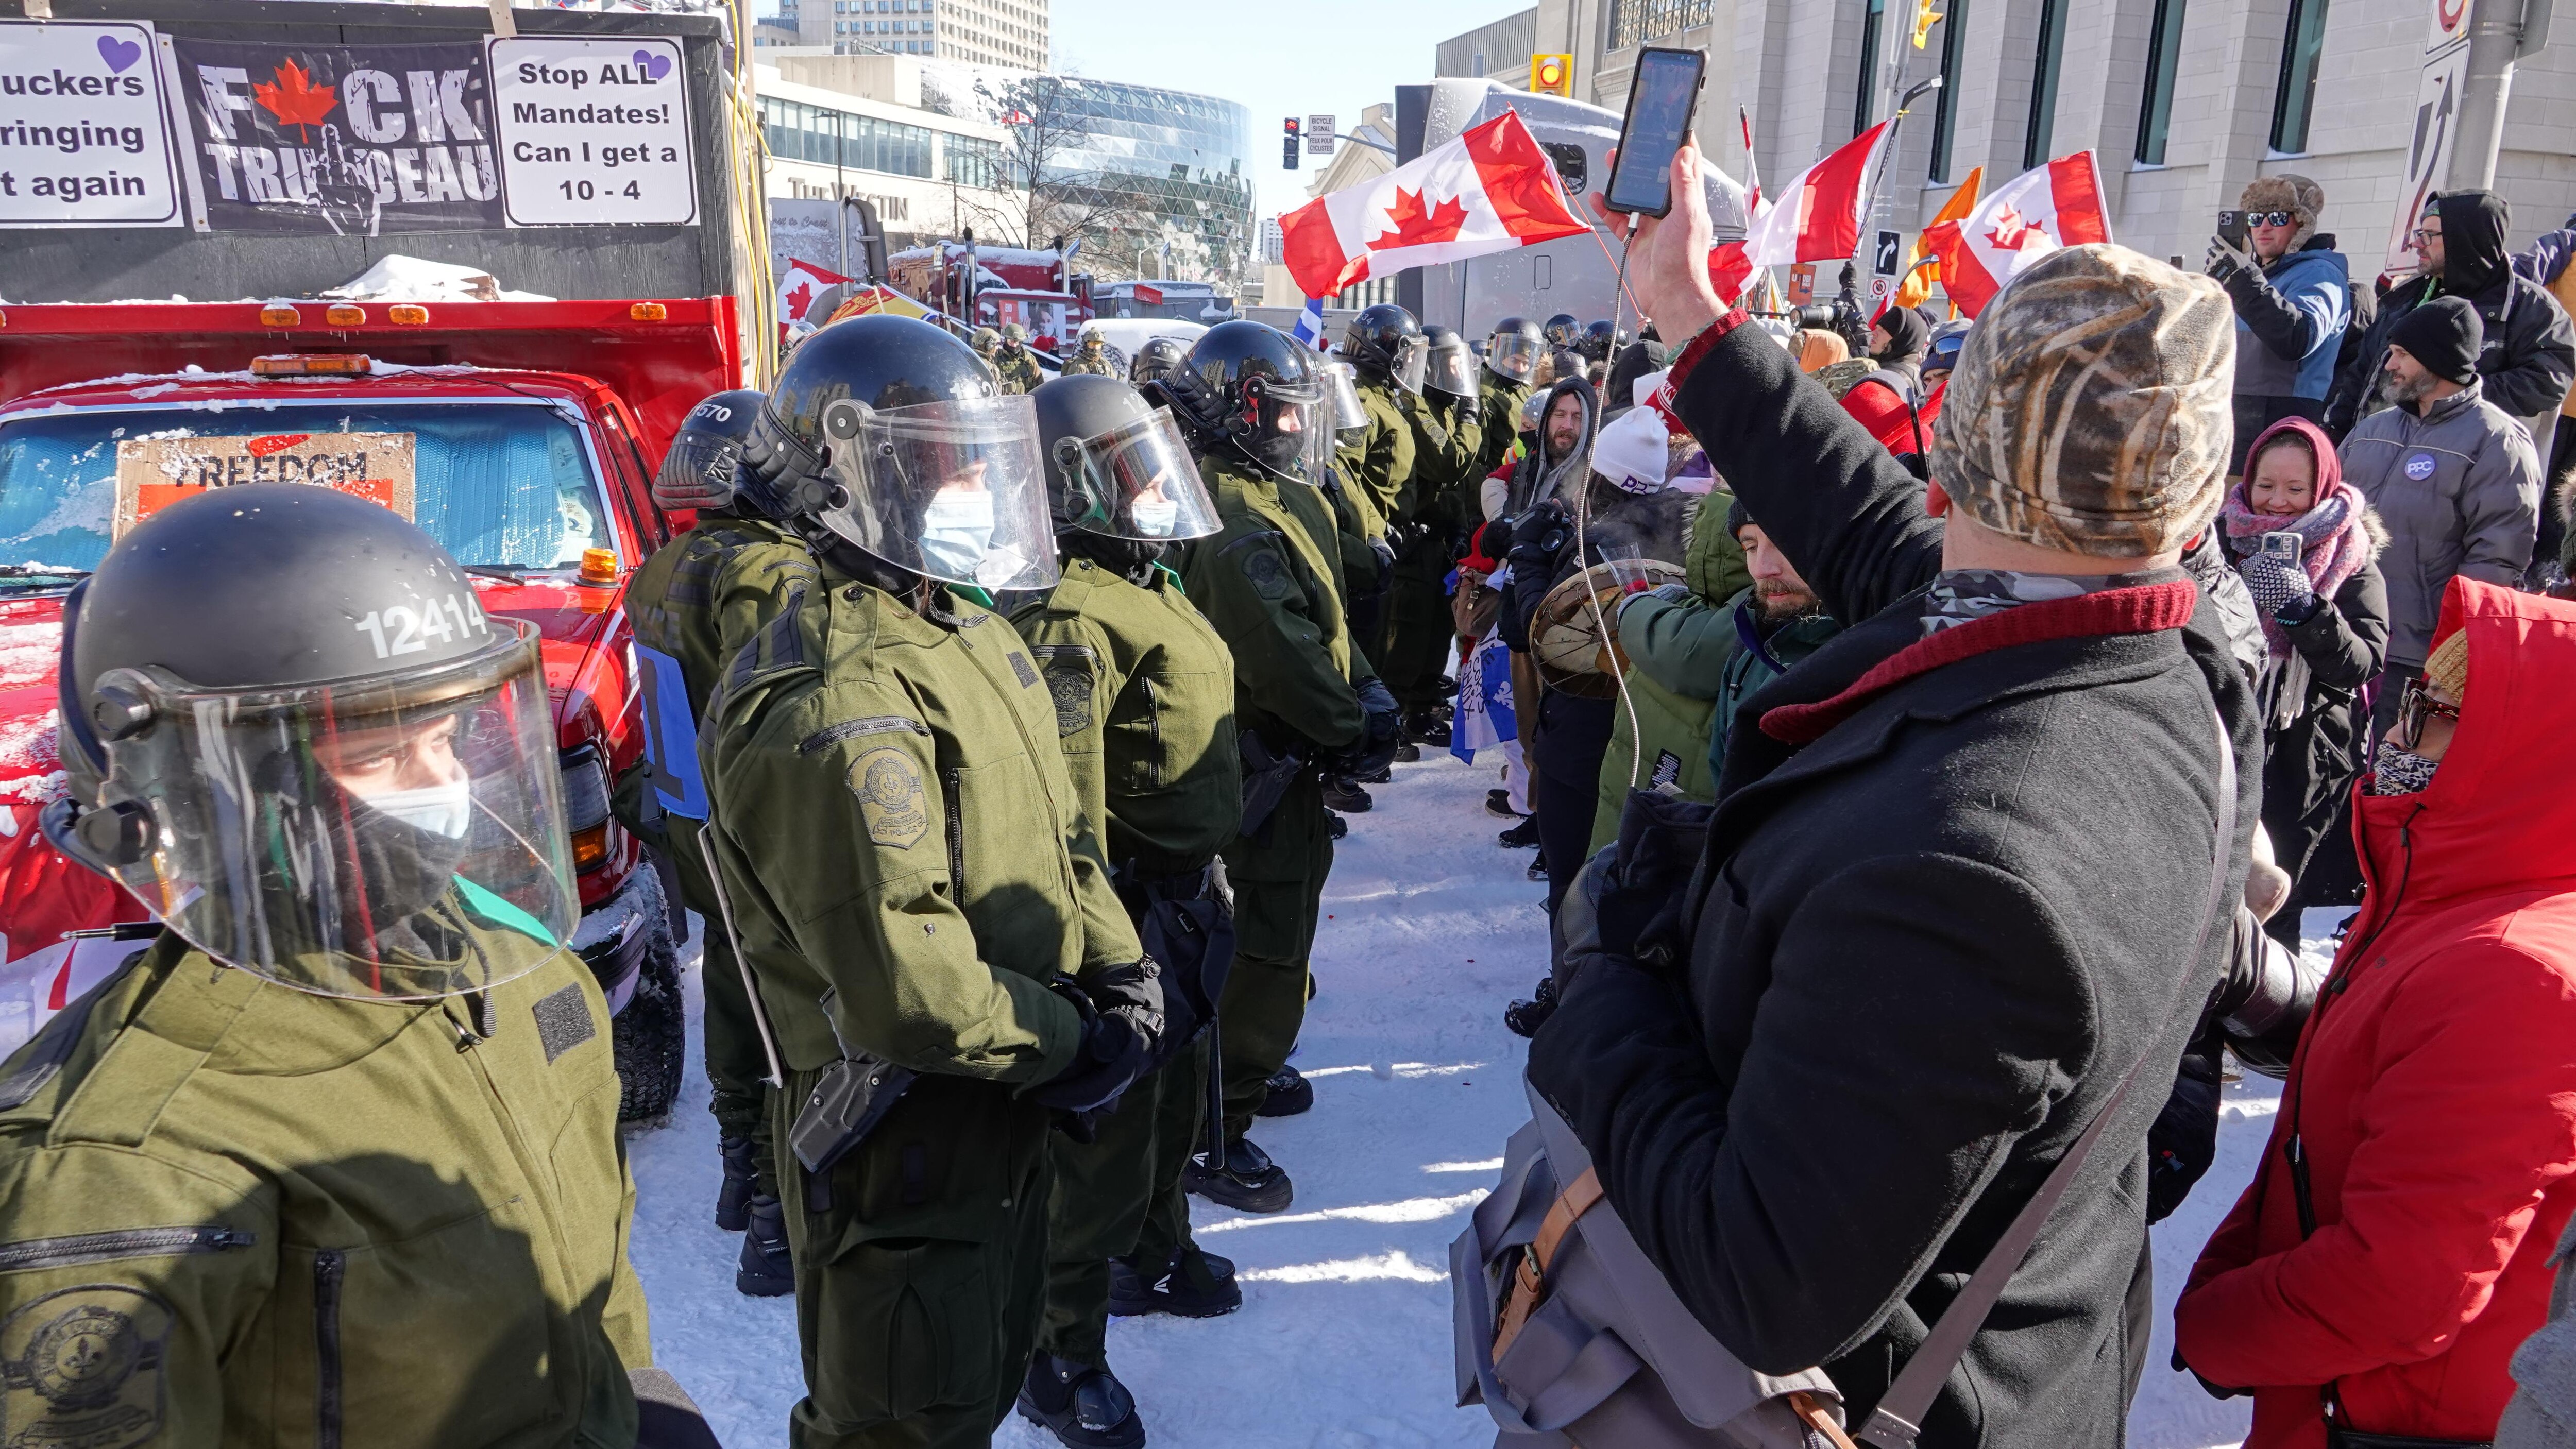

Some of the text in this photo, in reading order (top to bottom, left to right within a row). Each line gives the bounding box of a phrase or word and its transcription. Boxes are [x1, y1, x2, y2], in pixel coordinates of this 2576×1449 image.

[1, 69, 144, 96] uckers
[519, 63, 657, 90] Stop ALL
[513, 103, 670, 124] Mandates!
[0, 120, 144, 154] ringing
[514, 141, 677, 168] Can I get a
[31, 171, 146, 203] again
[560, 180, 594, 201] 10
[623, 180, 641, 200] 4
[2408, 461, 2432, 474] PPC
[354, 592, 487, 659] 12414
